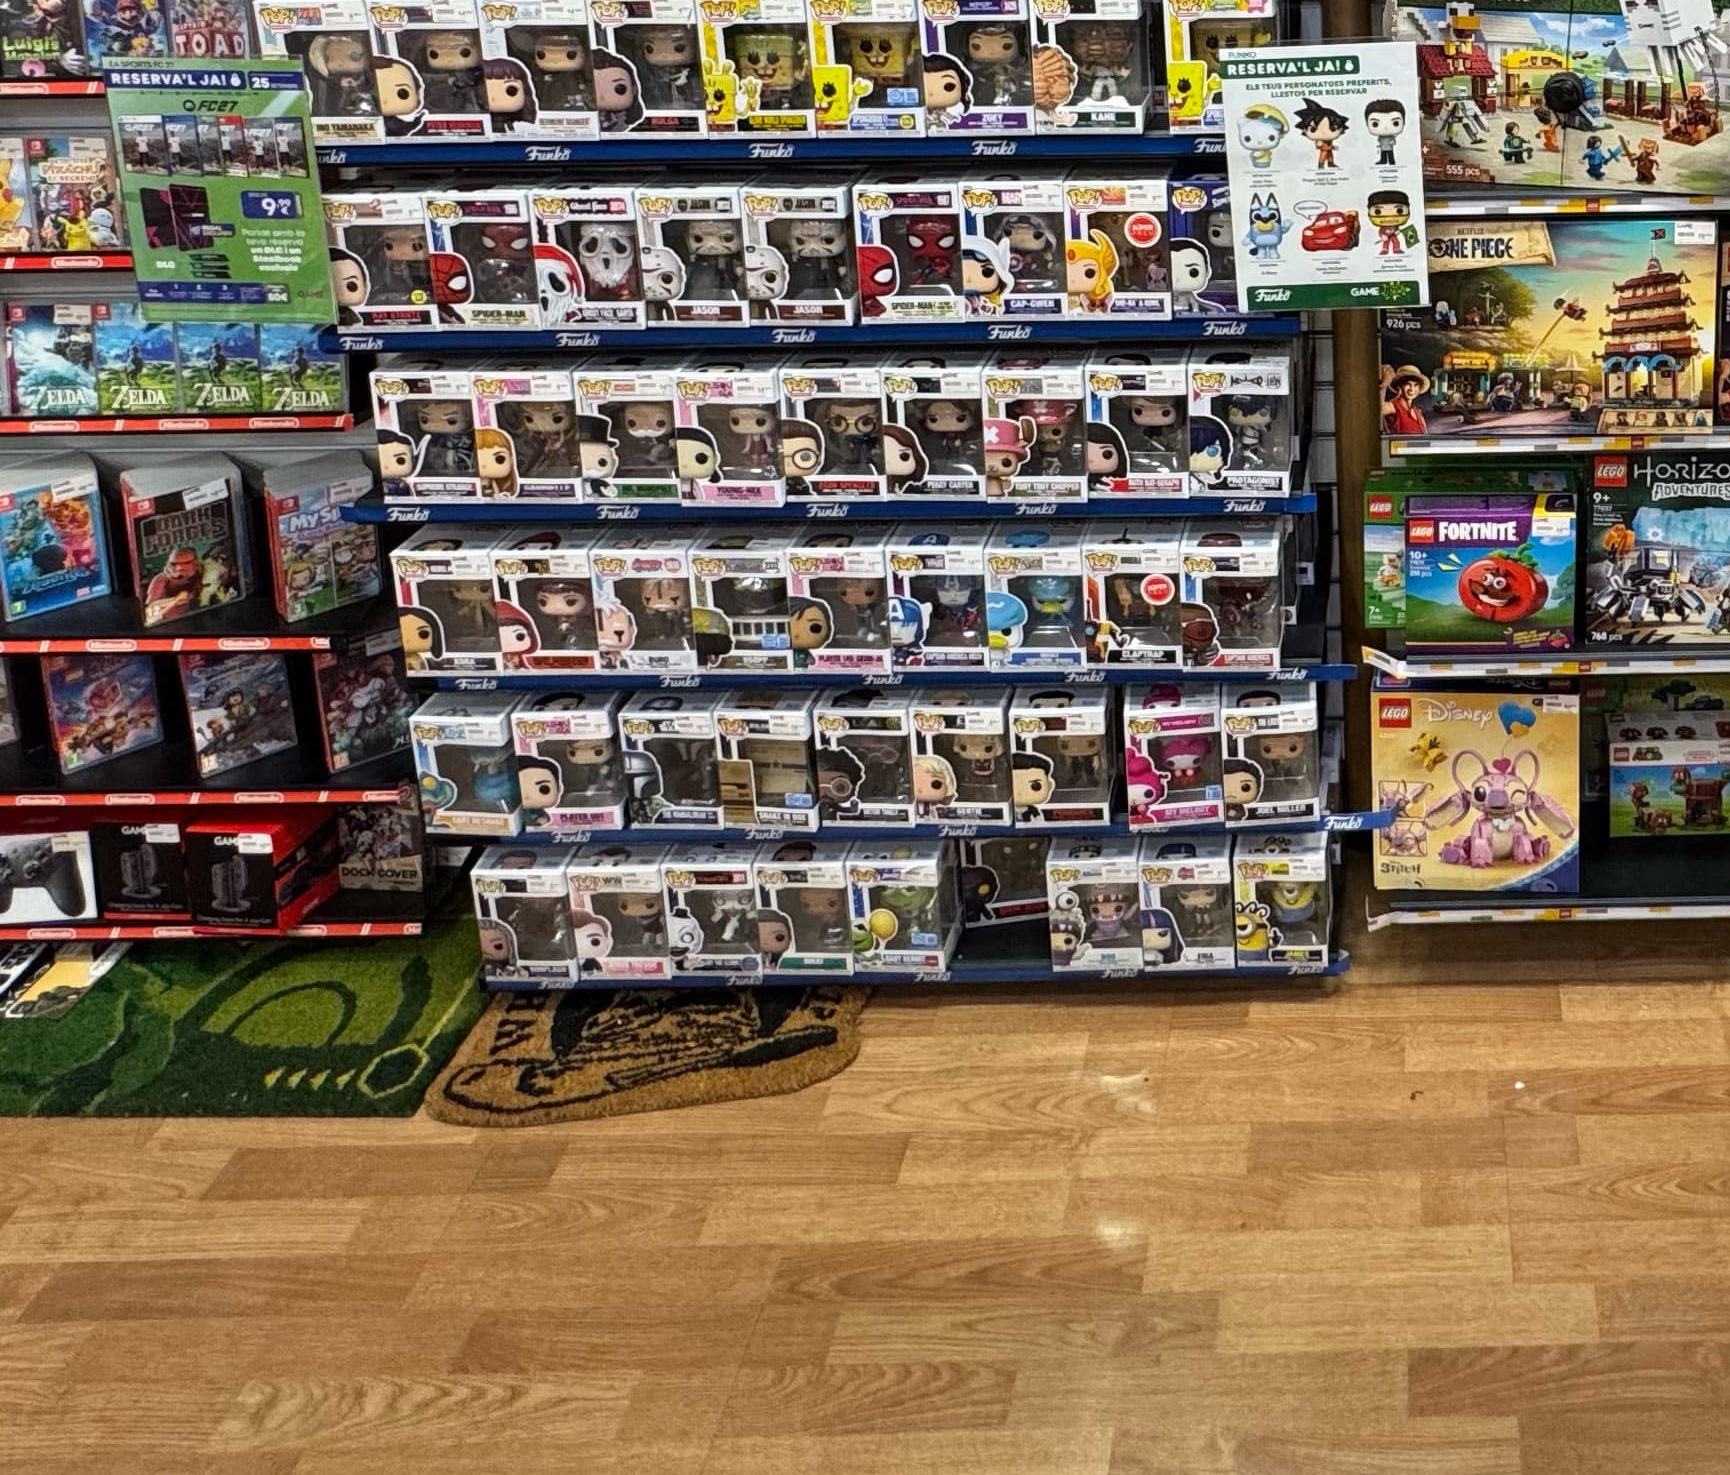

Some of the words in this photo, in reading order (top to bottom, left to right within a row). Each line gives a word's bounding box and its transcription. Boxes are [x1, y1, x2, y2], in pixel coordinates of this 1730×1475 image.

[3, 36, 59, 52] Luigi's
[175, 35, 245, 55] TOAD
[5, 50, 60, 61] Mansion
[1227, 62, 1310, 75] RESERVA'L
[1314, 61, 1340, 73] JA!
[111, 72, 195, 86] RESERVA'L
[200, 74, 226, 87] JA!
[251, 76, 269, 88] 25
[1346, 79, 1392, 87] PREFERITS,
[1325, 88, 1367, 96] RESERVAR
[199, 100, 238, 112] FC27
[1446, 165, 1461, 176] 555
[1463, 167, 1480, 178] pcs
[1429, 237, 1469, 258] ONE
[1471, 236, 1514, 259] PIECE
[1255, 288, 1291, 303] Funko
[1351, 287, 1380, 296] GAME
[471, 310, 526, 320] SPIDER-MAN
[690, 306, 721, 316] JASON
[25, 386, 85, 408] ZELDA
[1438, 521, 1517, 542] FORTNITE
[1417, 697, 1492, 728] Disney
[341, 869, 373, 879] DOCK
[377, 867, 417, 878] COVER
